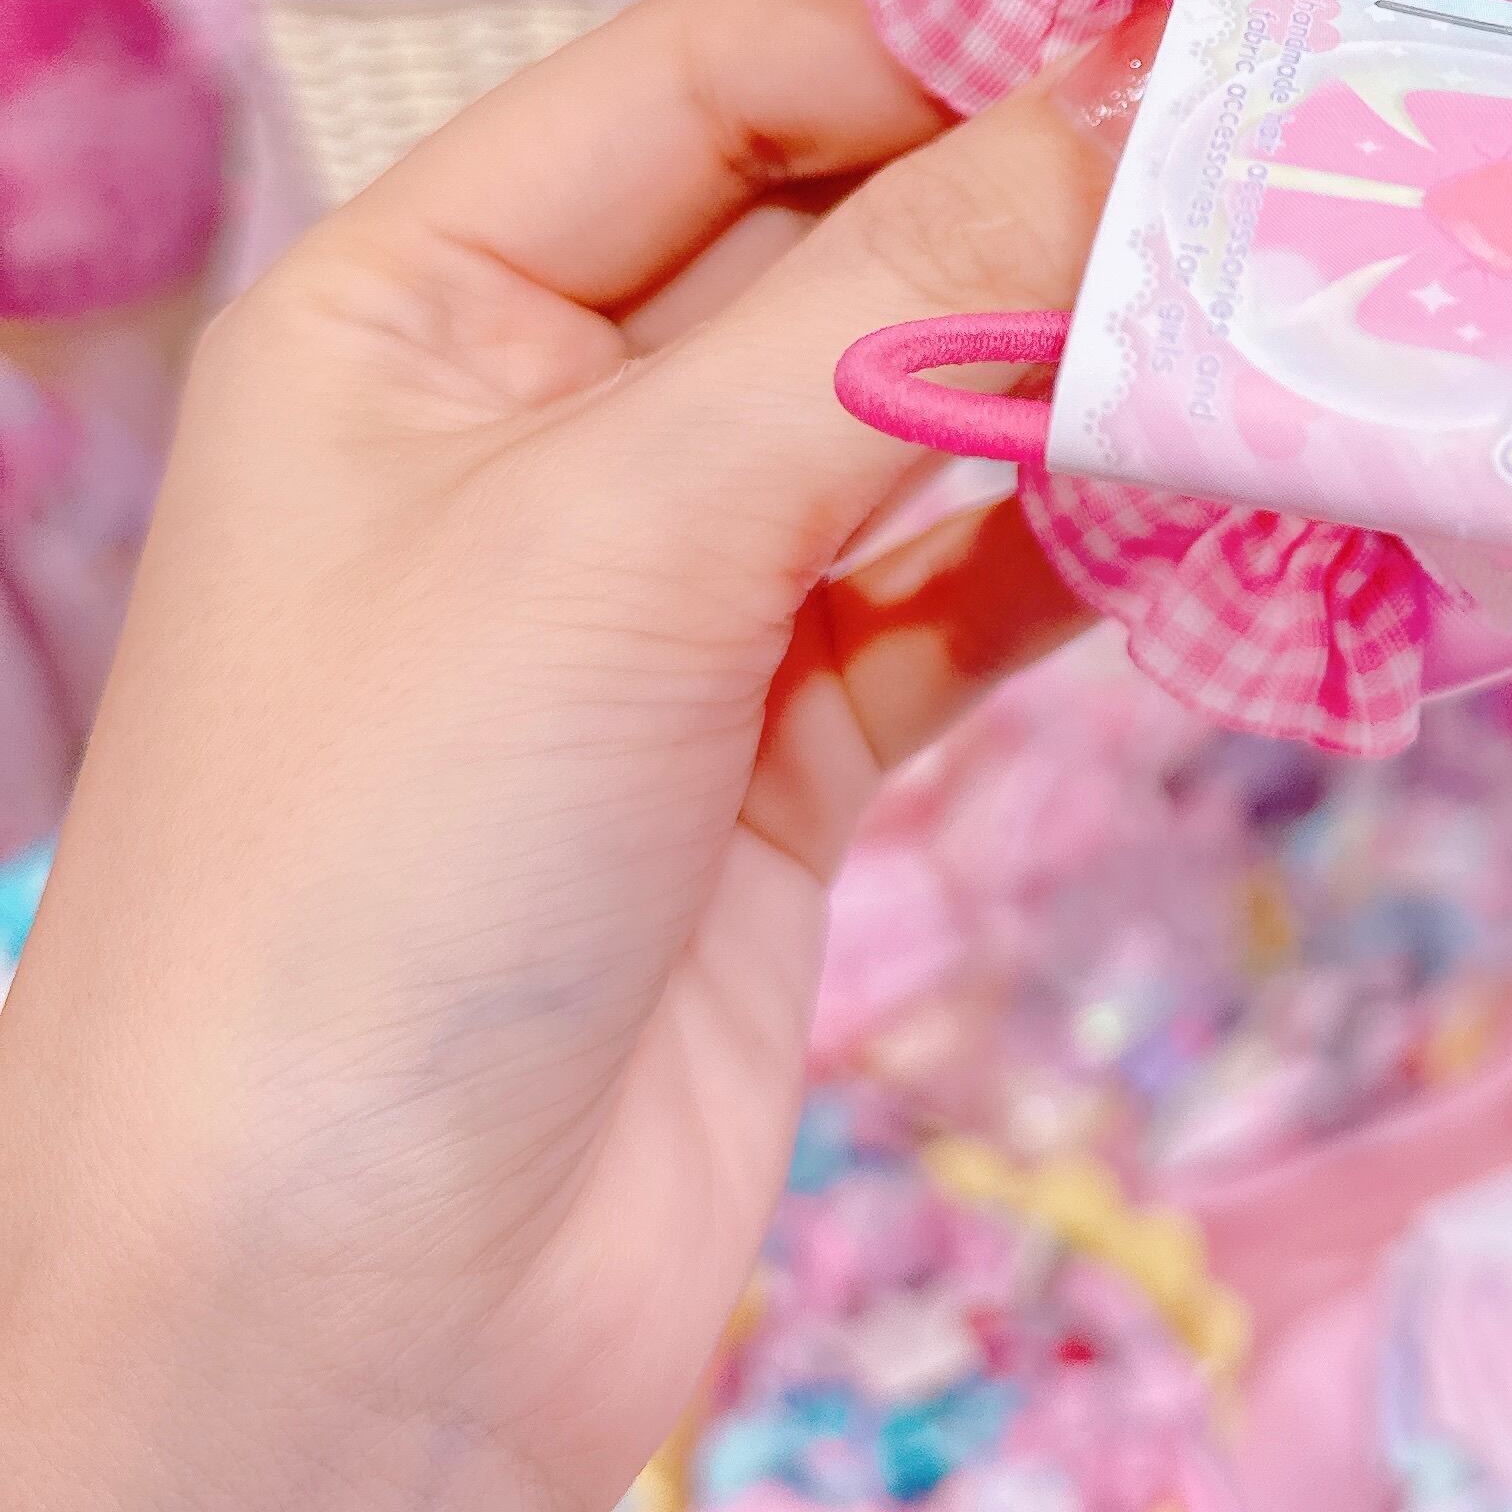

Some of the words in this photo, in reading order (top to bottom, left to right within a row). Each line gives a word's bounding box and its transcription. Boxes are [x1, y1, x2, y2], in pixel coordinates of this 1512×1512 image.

[1234, 8, 1279, 73] fabric
[1271, 0, 1328, 103] handmade
[1187, 83, 1247, 228] accessories
[1175, 241, 1210, 287] for
[1207, 163, 1268, 338] accessories
[1150, 303, 1186, 372] girls
[1188, 354, 1221, 423] and
